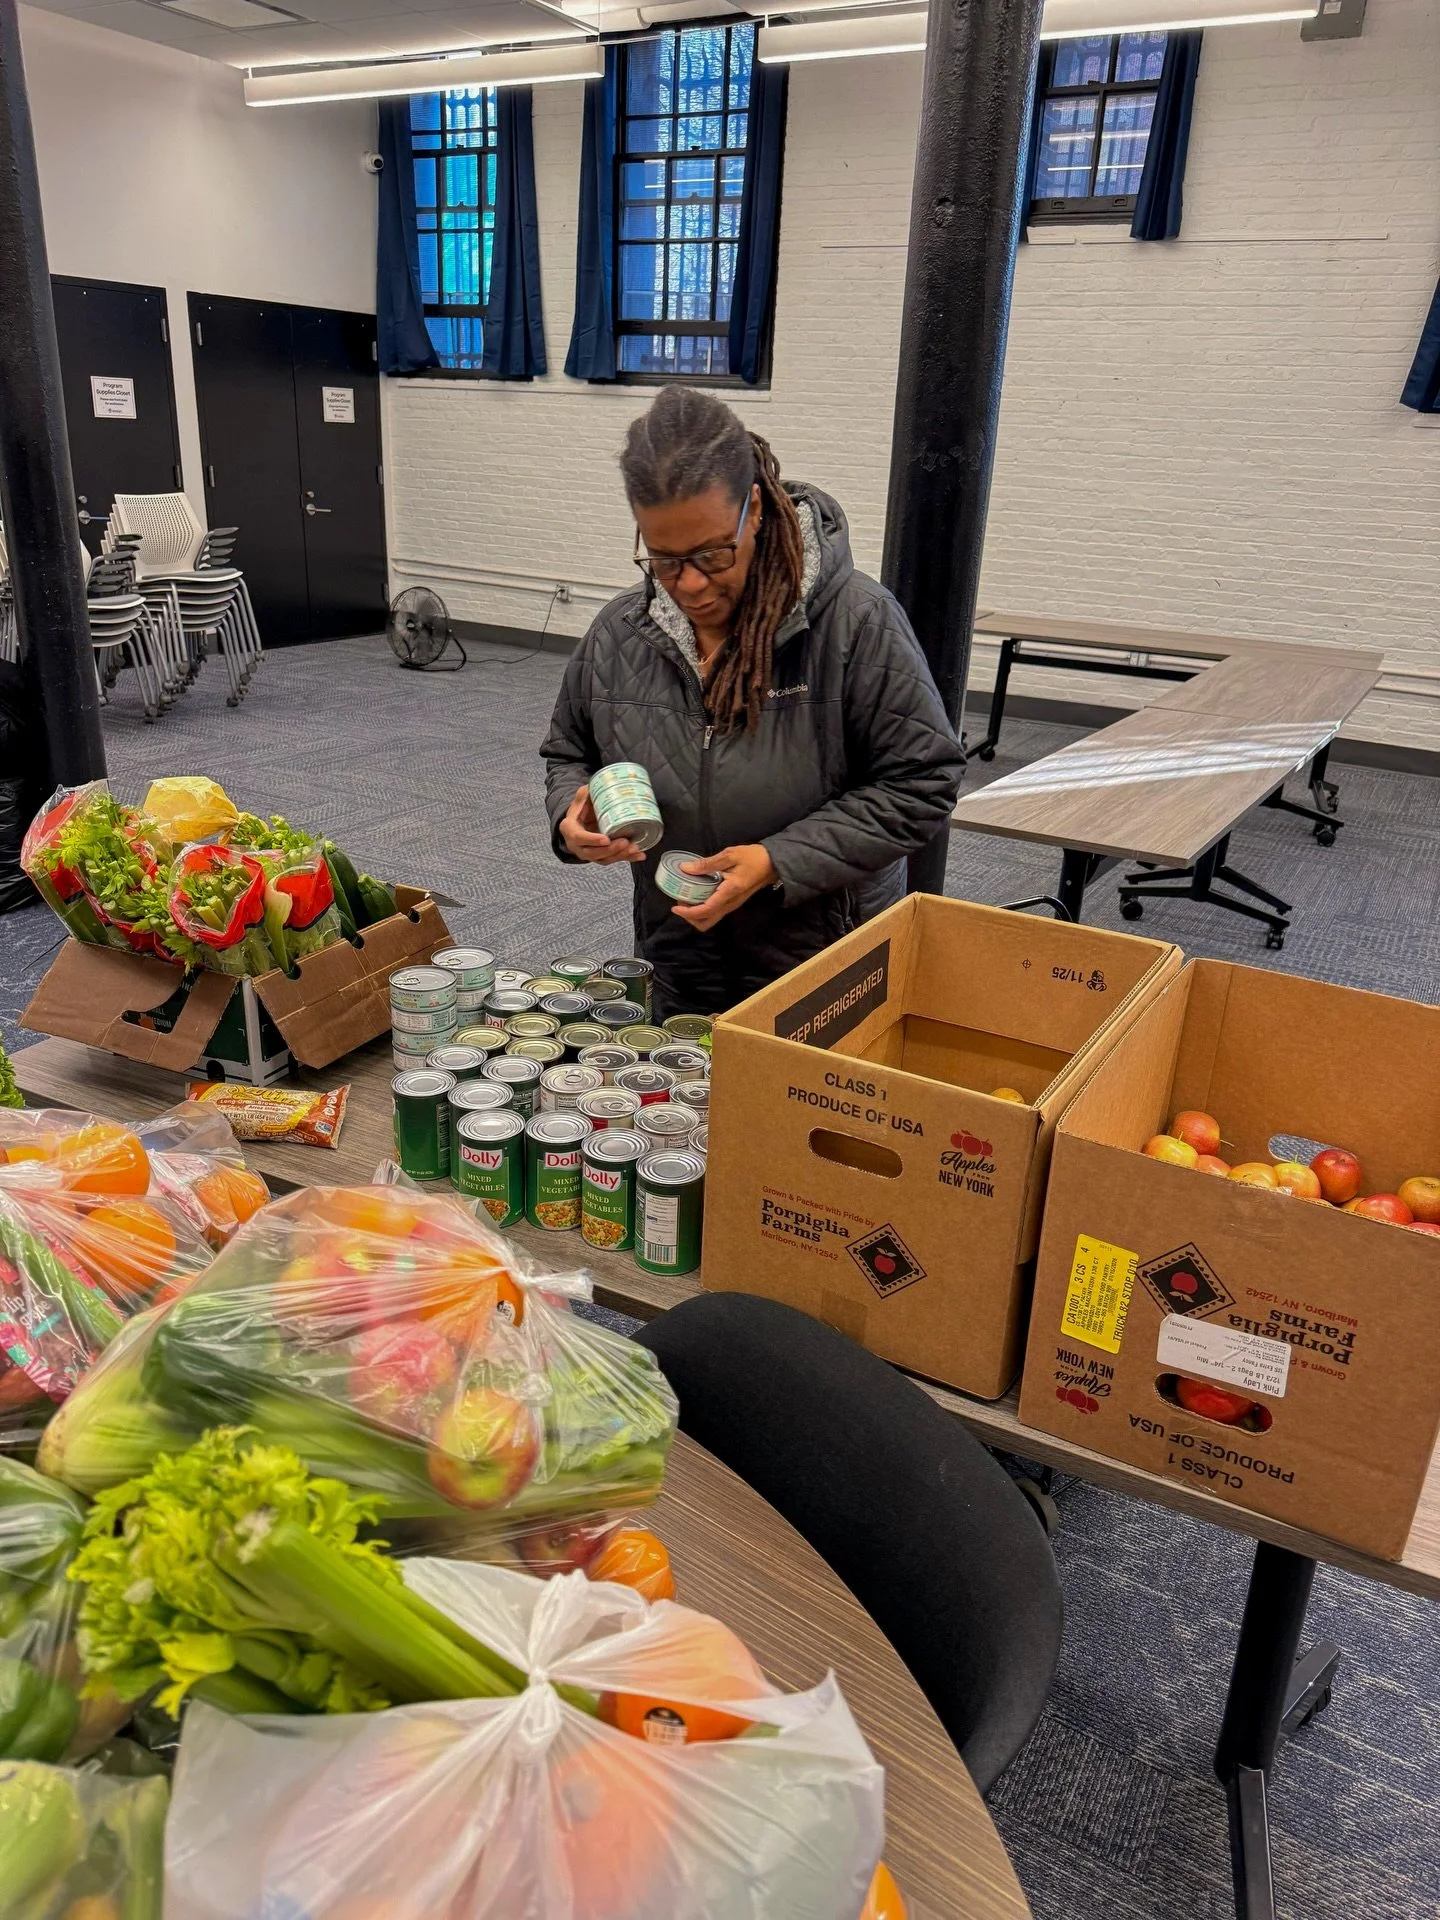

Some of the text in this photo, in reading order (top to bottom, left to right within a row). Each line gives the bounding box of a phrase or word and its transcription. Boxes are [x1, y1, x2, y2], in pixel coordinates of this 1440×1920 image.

[776, 684, 808, 697] Columbia
[1052, 966, 1084, 983] 11/25
[786, 968, 884, 1043] EEP REFRIGERATED
[824, 1072, 887, 1101] CLASS 1
[788, 1086, 923, 1136] PRODUCE OF USA
[463, 1146, 500, 1168] Dolly
[941, 1151, 996, 1173] Apples
[467, 1172, 491, 1183] MIXED
[554, 1176, 580, 1185] MIXED
[584, 1164, 619, 1189] Dolly
[939, 1169, 994, 1198] NEW YORK
[586, 1192, 609, 1204] MIXED
[762, 1185, 787, 1199] Grown
[796, 1195, 823, 1210] Packed
[825, 1205, 842, 1216] with
[844, 1211, 863, 1224] Pride
[865, 1218, 875, 1228] by
[761, 1212, 820, 1243] Farms
[762, 1198, 850, 1238] Porpiglia
[761, 1229, 839, 1260] Marlboro, NY 12542
[1127, 1259, 1138, 1275] 010
[1067, 1294, 1080, 1324] CA1001
[1076, 1263, 1086, 1276] CS
[1122, 1277, 1134, 1300] STOP
[1120, 1301, 1129, 1312] 82
[1246, 1287, 1358, 1328] Marlboro, NY 12542
[1113, 1314, 1126, 1341] TRUCK
[1227, 1313, 1353, 1365] Porpiglia
[1270, 1309, 1357, 1348] Farms
[1056, 1347, 1114, 1380] NEW YORK
[1237, 1367, 1254, 1376] Bags
[1242, 1357, 1258, 1367] Fancy
[1259, 1363, 1273, 1371] Extra
[1311, 1363, 1346, 1381] Grown
[1053, 1371, 1111, 1397] Apples
[1243, 1377, 1280, 1394] Pink Lady
[1266, 1375, 1281, 1384] 12/3
[1129, 1414, 1295, 1484] PRODUCE OF USA
[1168, 1453, 1243, 1489] CLASS 1
